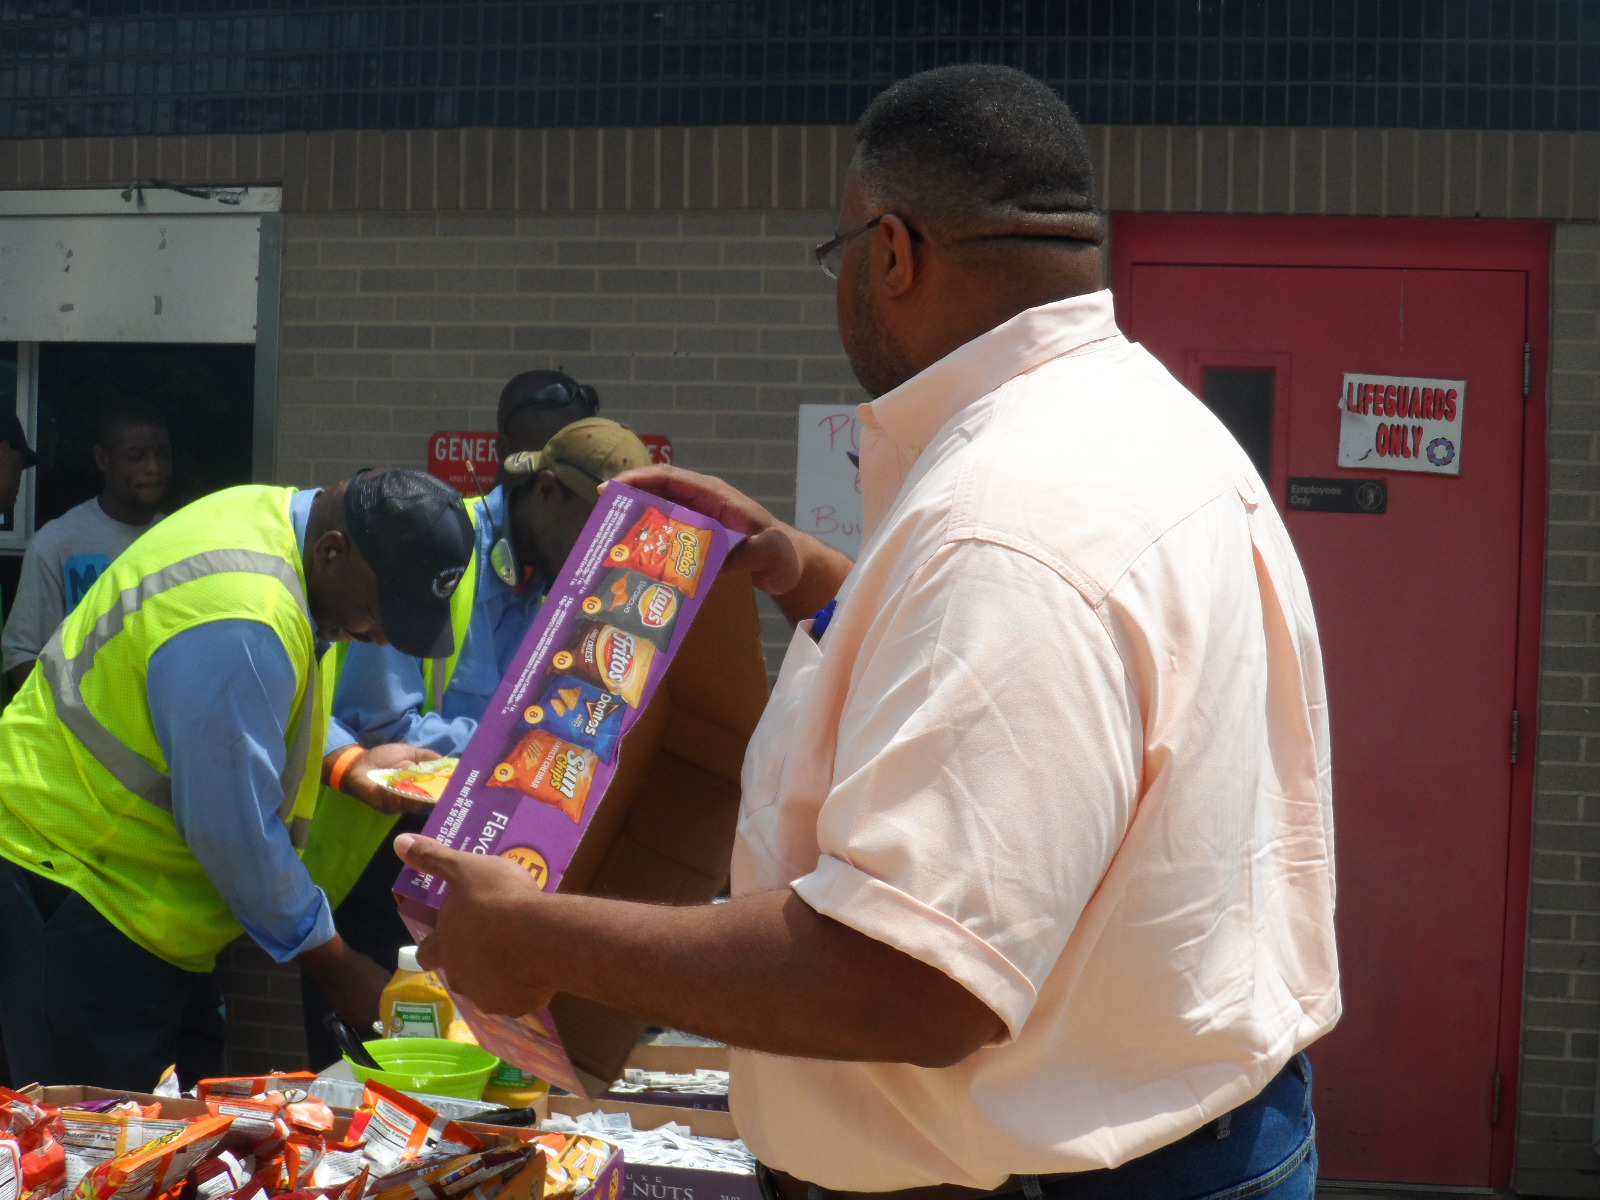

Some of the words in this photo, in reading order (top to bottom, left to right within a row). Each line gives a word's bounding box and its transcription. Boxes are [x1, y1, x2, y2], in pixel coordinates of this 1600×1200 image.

[1346, 381, 1458, 422] LIFEGUARDS
[1375, 422, 1424, 459] ONLY
[435, 437, 499, 462] GENER
[1291, 484, 1342, 496] Employees
[1291, 495, 1313, 506] Only
[613, 546, 624, 558] 16
[675, 530, 697, 577] Cheetos
[586, 598, 597, 610] 10
[623, 580, 645, 613] Barbecue
[646, 588, 673, 626] Lay's
[556, 653, 568, 666] 10
[606, 632, 634, 684] Fritos
[529, 710, 538, 718] 8
[583, 692, 611, 735] Doritos
[545, 740, 561, 761] HARVEST
[464, 767, 479, 787] TOTAL
[499, 767, 508, 776] 6
[529, 760, 550, 789] CHEDDAR
[549, 753, 567, 790] Chips
[557, 750, 584, 798] Sun
[458, 785, 470, 798] NET
[452, 795, 464, 809] WT.
[463, 798, 473, 807] 50
[448, 807, 458, 817] 50
[442, 815, 454, 828] OZ.
[446, 805, 468, 840] INDIVIDUAL
[473, 811, 509, 855] Flavo
[441, 837, 452, 847] BA
[420, 873, 434, 890] EACH
[694, 1103, 729, 1111] DEL
[626, 1174, 662, 1183] UXE
[633, 1183, 694, 1200] NUTS
